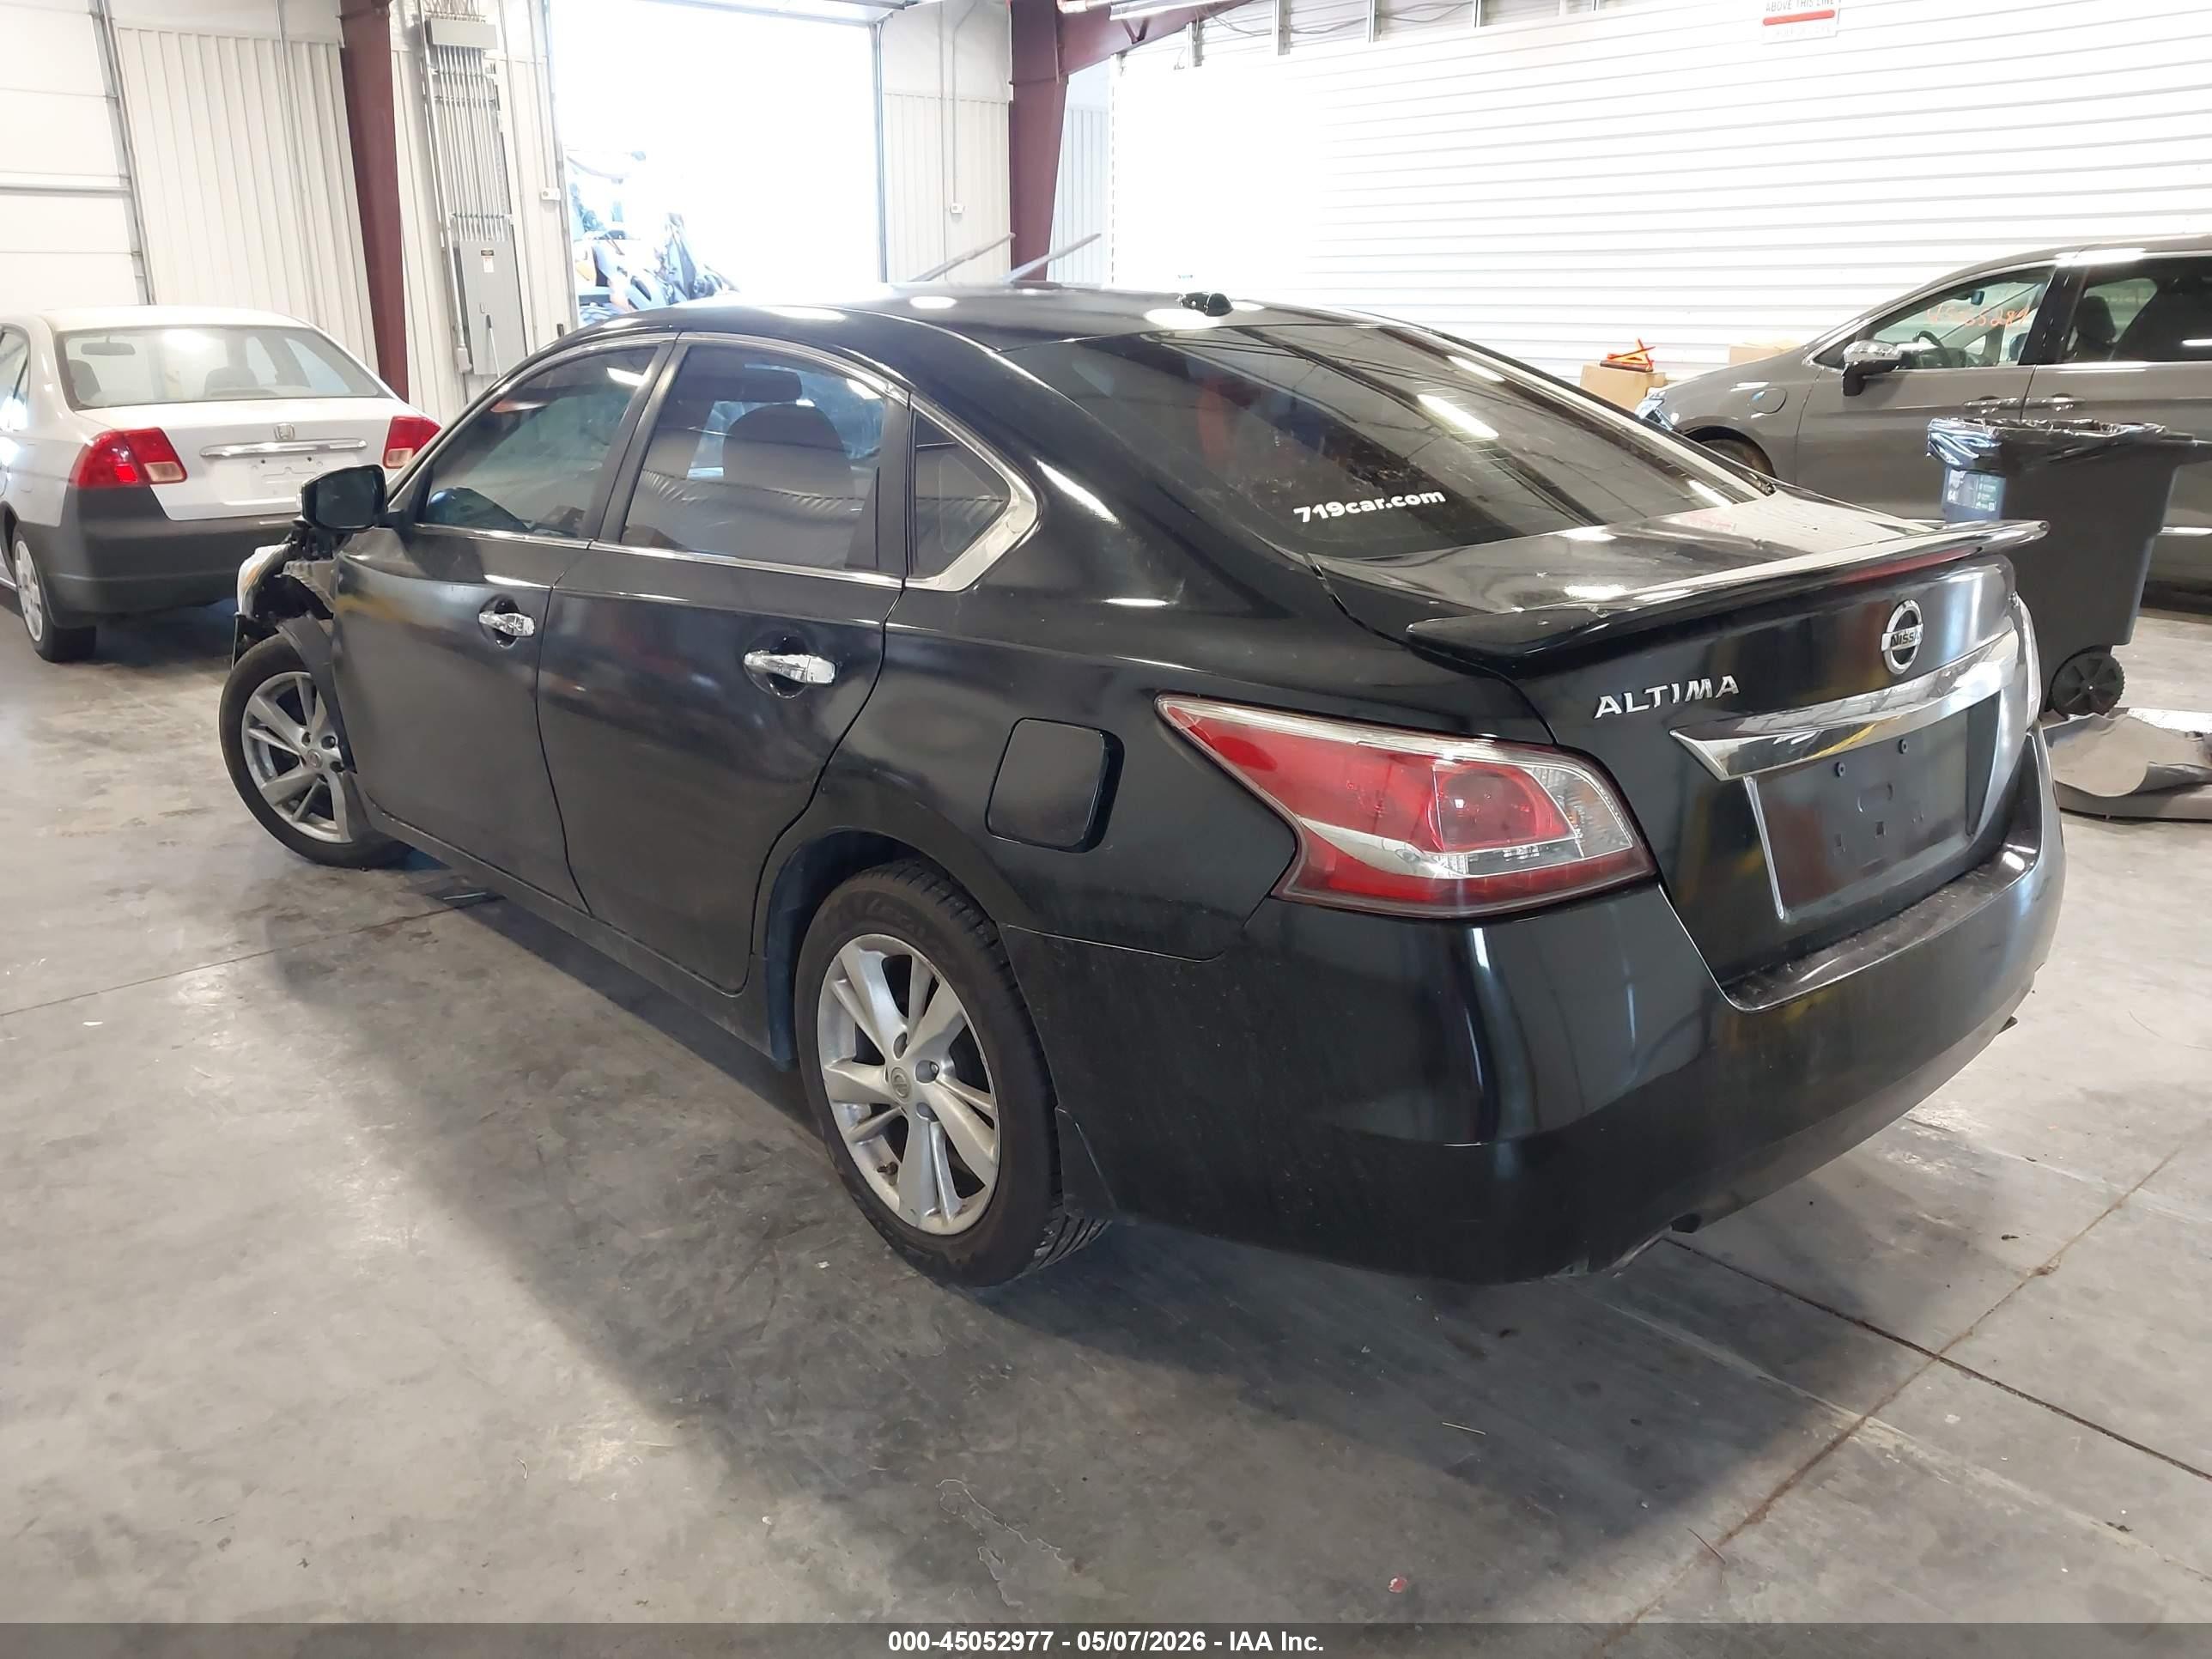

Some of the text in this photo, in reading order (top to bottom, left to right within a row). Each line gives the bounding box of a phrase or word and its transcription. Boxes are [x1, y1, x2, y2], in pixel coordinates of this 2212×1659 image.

[1765, 0, 1792, 12] ABOVE
[1292, 490, 1447, 523] 719car.com
[1594, 675, 1741, 720] ALTIMA
